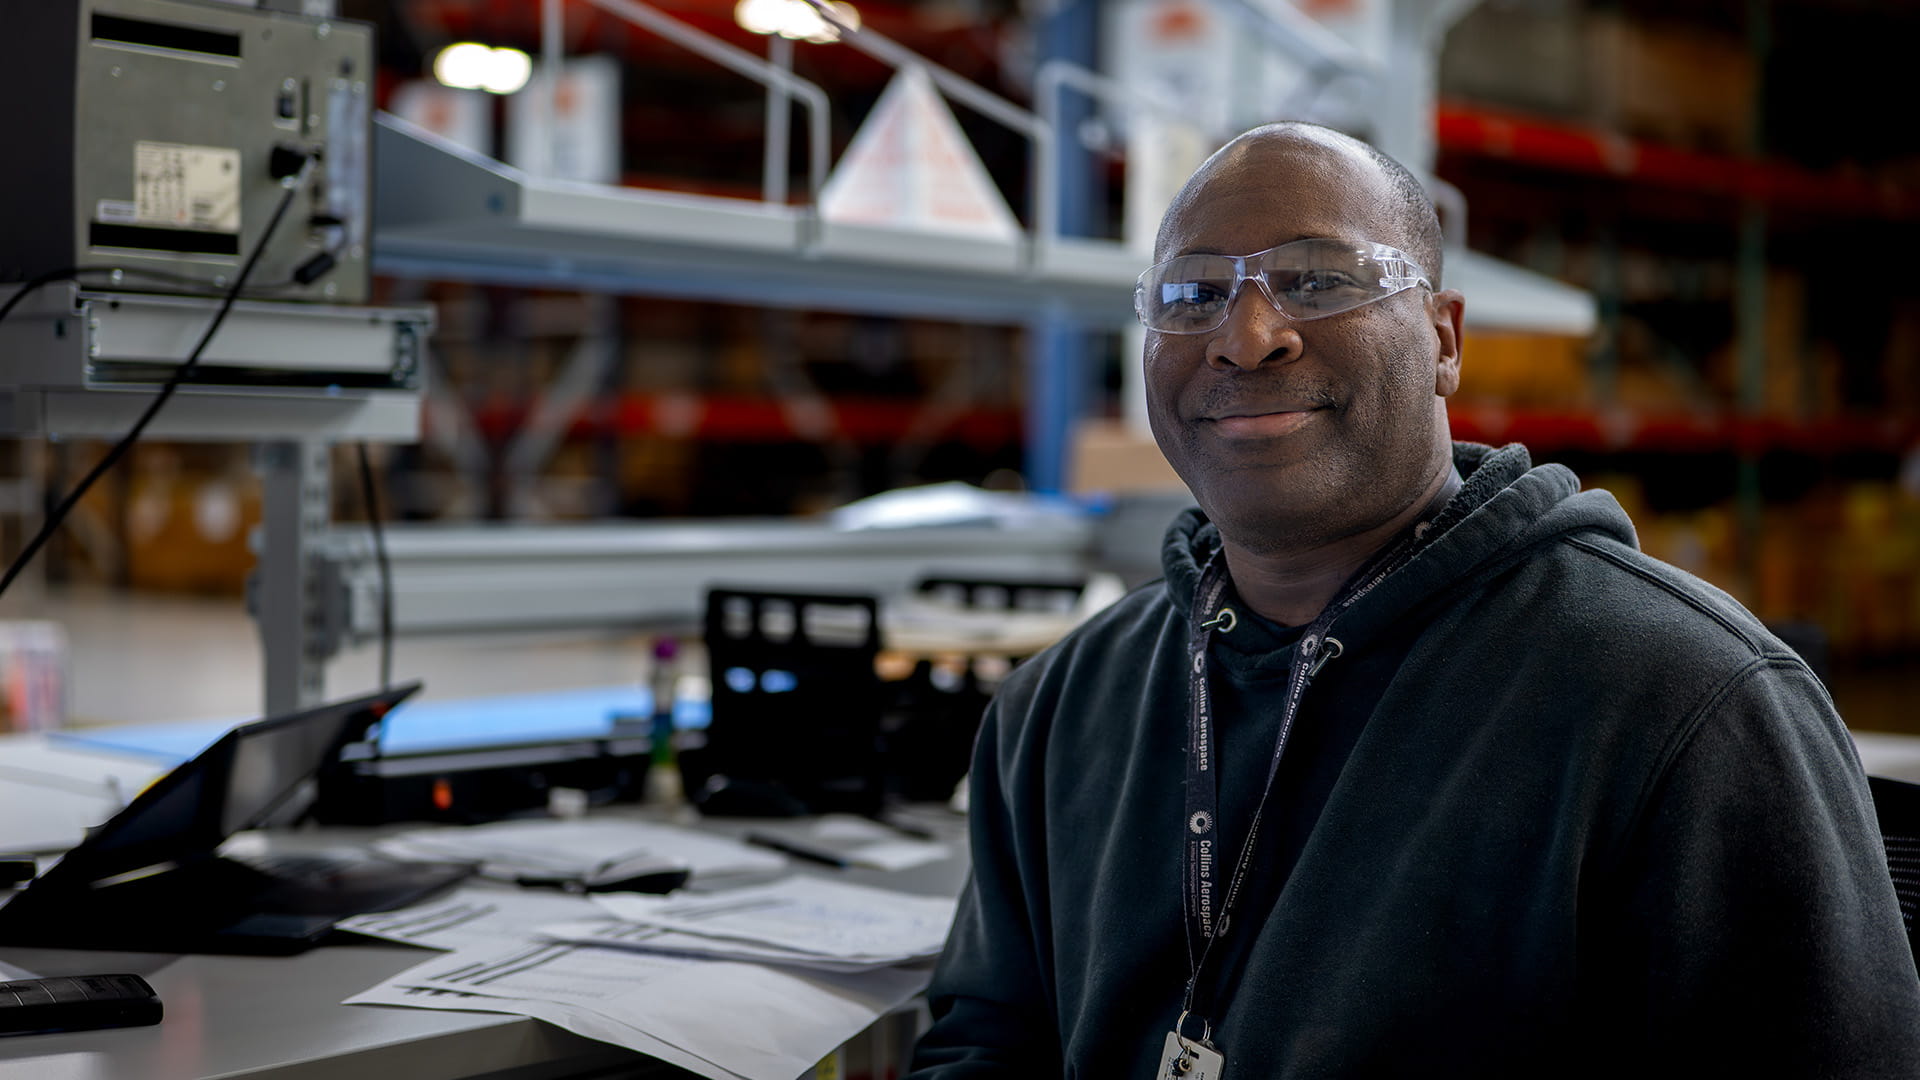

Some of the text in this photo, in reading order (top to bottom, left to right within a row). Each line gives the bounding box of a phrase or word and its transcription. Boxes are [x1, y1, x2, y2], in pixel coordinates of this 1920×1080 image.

[1293, 662, 1309, 700] Collins
[1198, 677, 1209, 771] Collins Aerospace
[1275, 701, 1297, 758] Aerospace
[1200, 840, 1212, 938] Collins Aerospace
